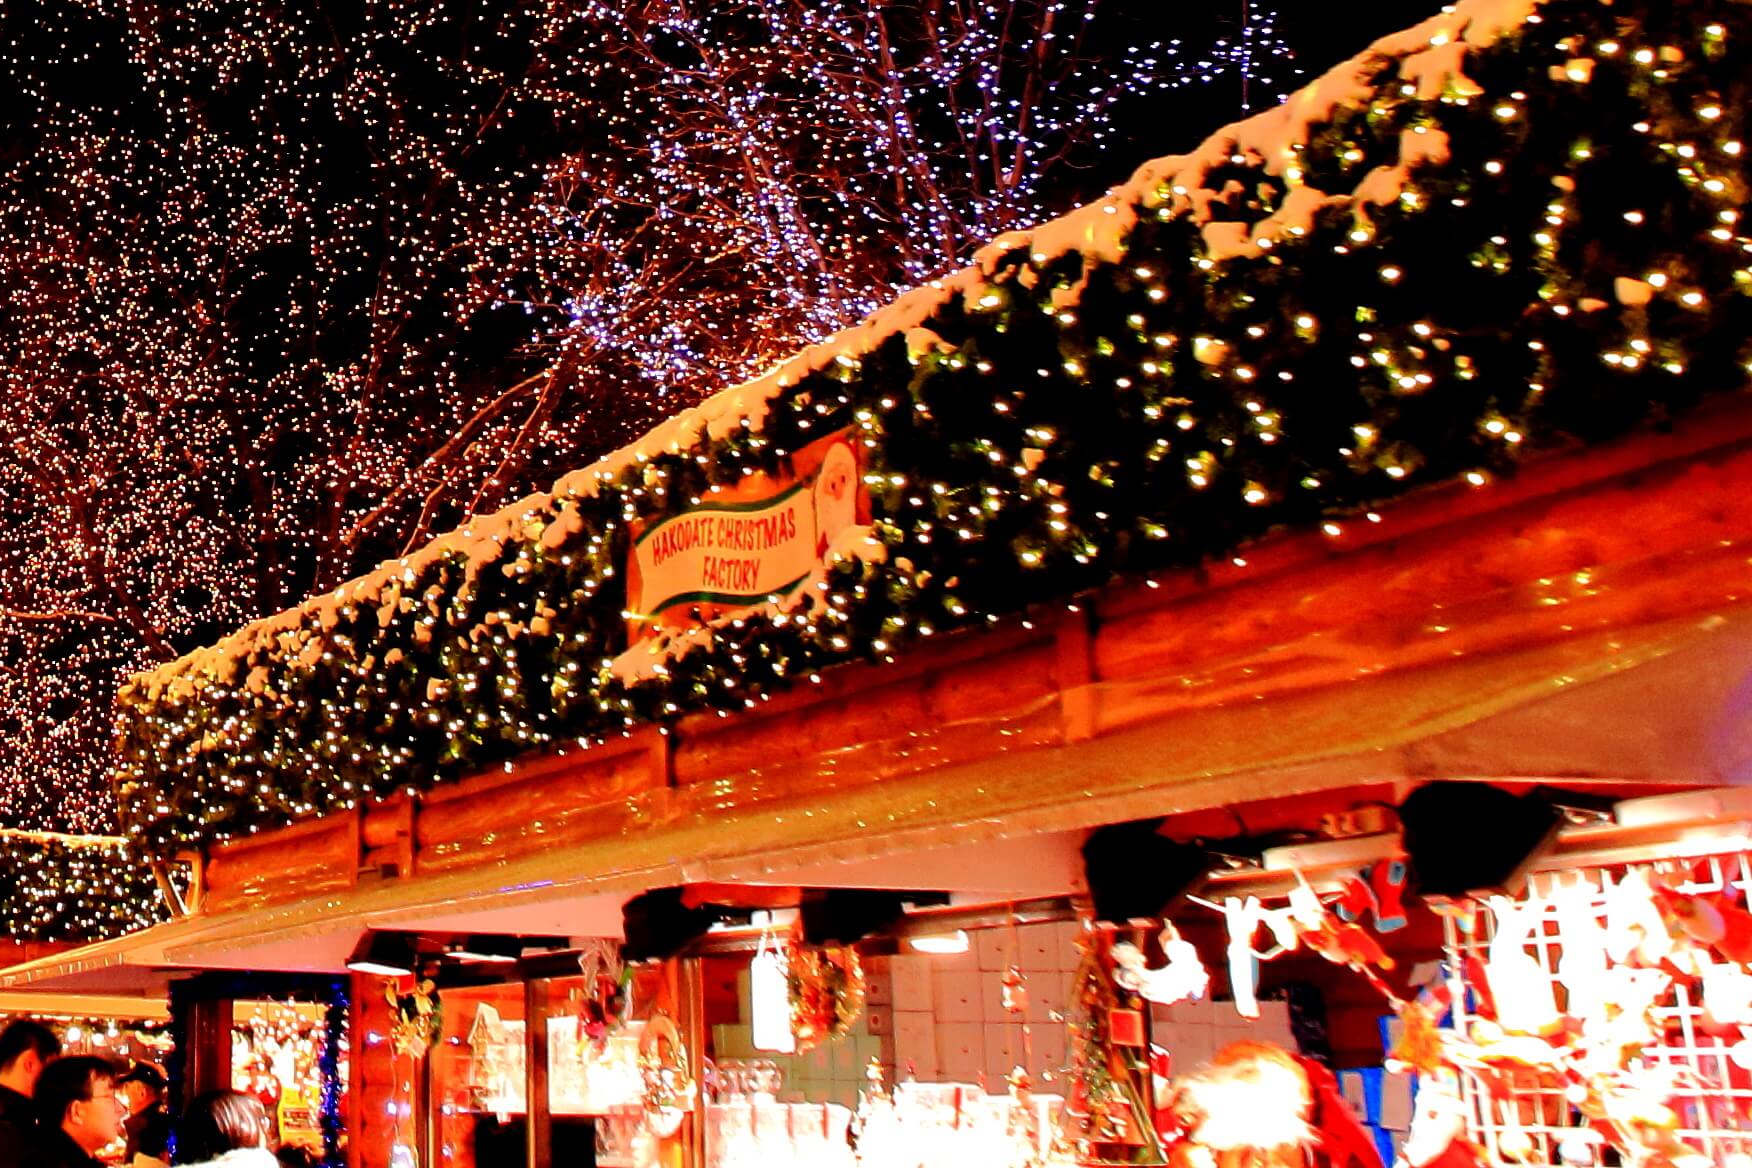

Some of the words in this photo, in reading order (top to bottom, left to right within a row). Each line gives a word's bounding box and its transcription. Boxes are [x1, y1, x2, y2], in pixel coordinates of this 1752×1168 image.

[652, 517, 714, 566] HAKODATE
[717, 507, 796, 551] CHRISTMAS
[703, 555, 761, 590] FACTORY
